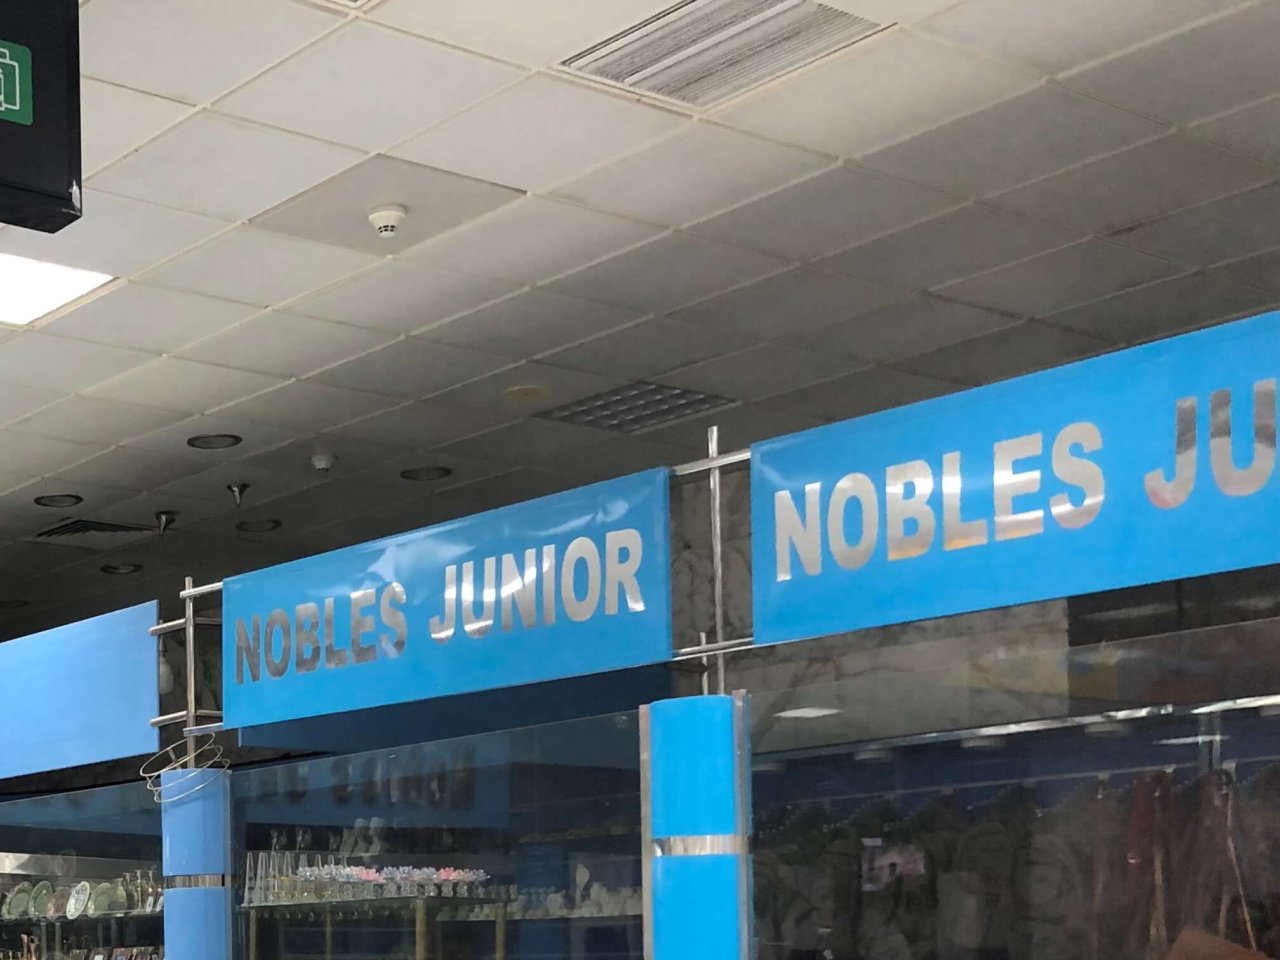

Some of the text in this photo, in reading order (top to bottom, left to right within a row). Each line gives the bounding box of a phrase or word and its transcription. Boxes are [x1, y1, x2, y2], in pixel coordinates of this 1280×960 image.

[774, 421, 1106, 583] NOBLES
[235, 528, 646, 685] NOBLES JUNIOR
